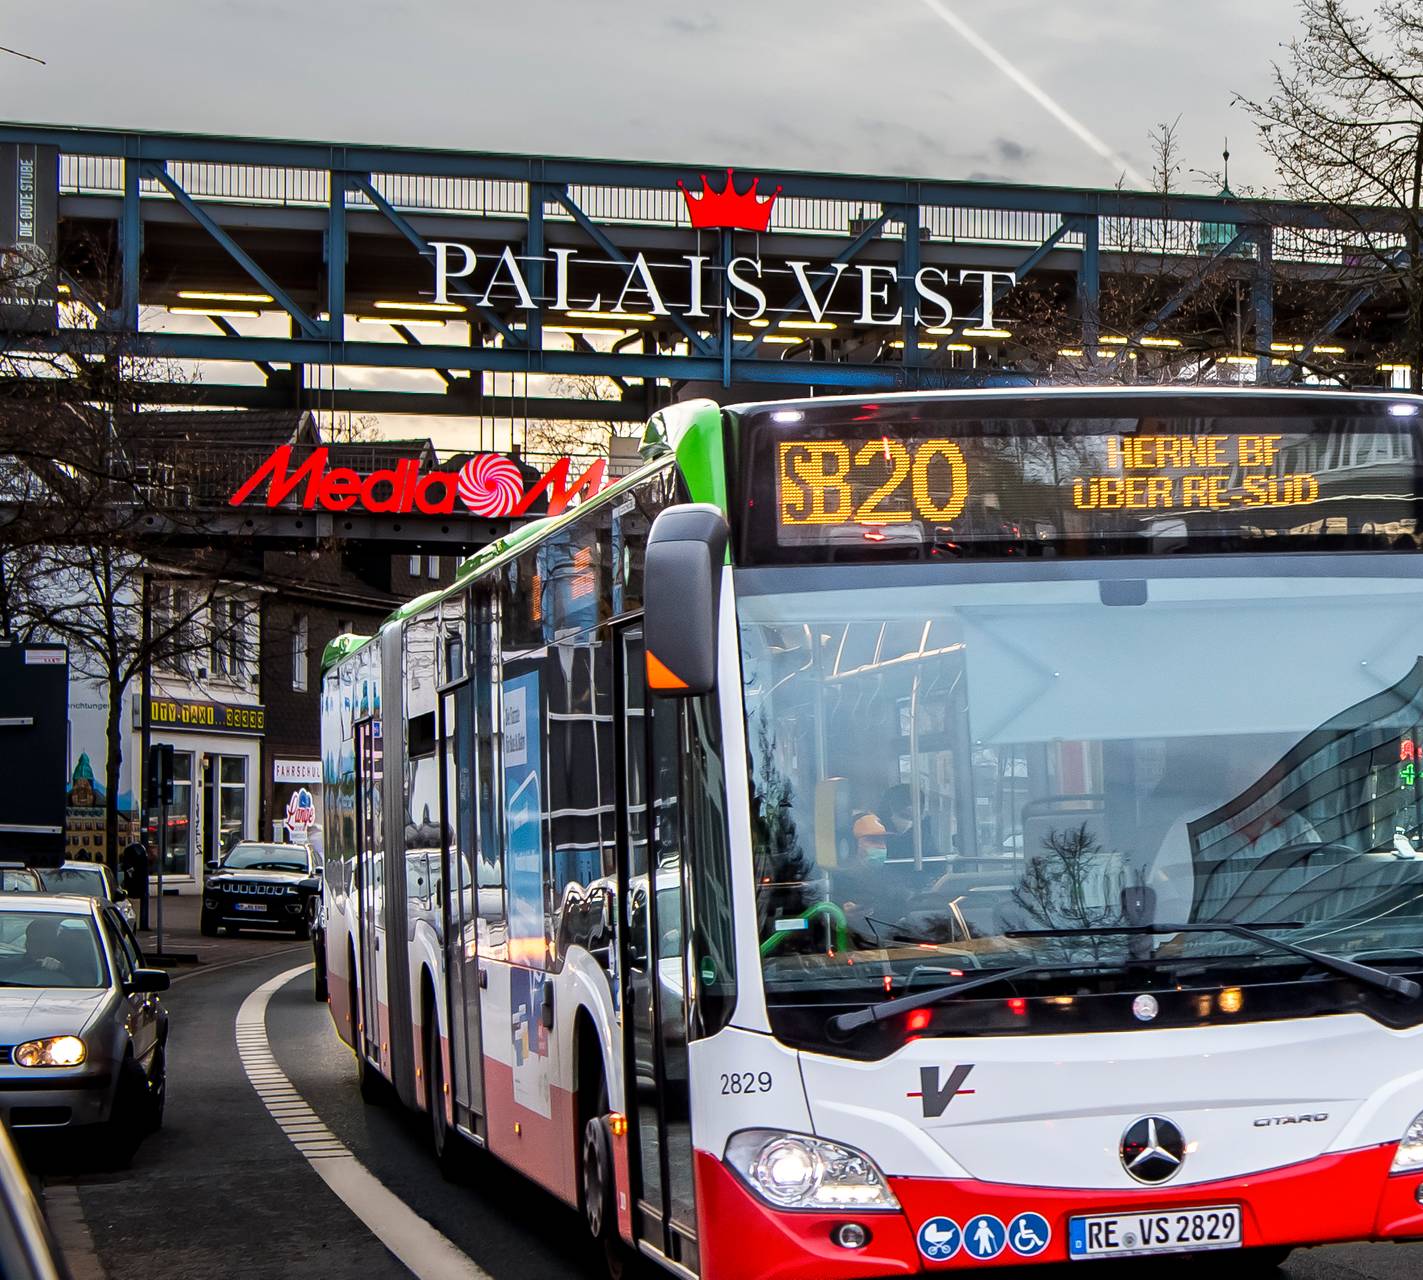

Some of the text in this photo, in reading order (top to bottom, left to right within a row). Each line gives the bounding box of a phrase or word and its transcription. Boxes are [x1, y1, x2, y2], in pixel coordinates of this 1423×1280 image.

[19, 159, 34, 237] DIE GUTE STUBE
[0, 296, 53, 307] ALAISVEST
[1106, 435, 1283, 469] HERNE BF
[779, 439, 969, 525] SB20
[1072, 474, 1320, 509] ÜBER RE-SÜD
[276, 764, 321, 778] FAHRSCHUL
[720, 1071, 772, 1095] 2829
[1253, 1112, 1329, 1128] CITARO
[1088, 1211, 1236, 1250] RE VS 2829
